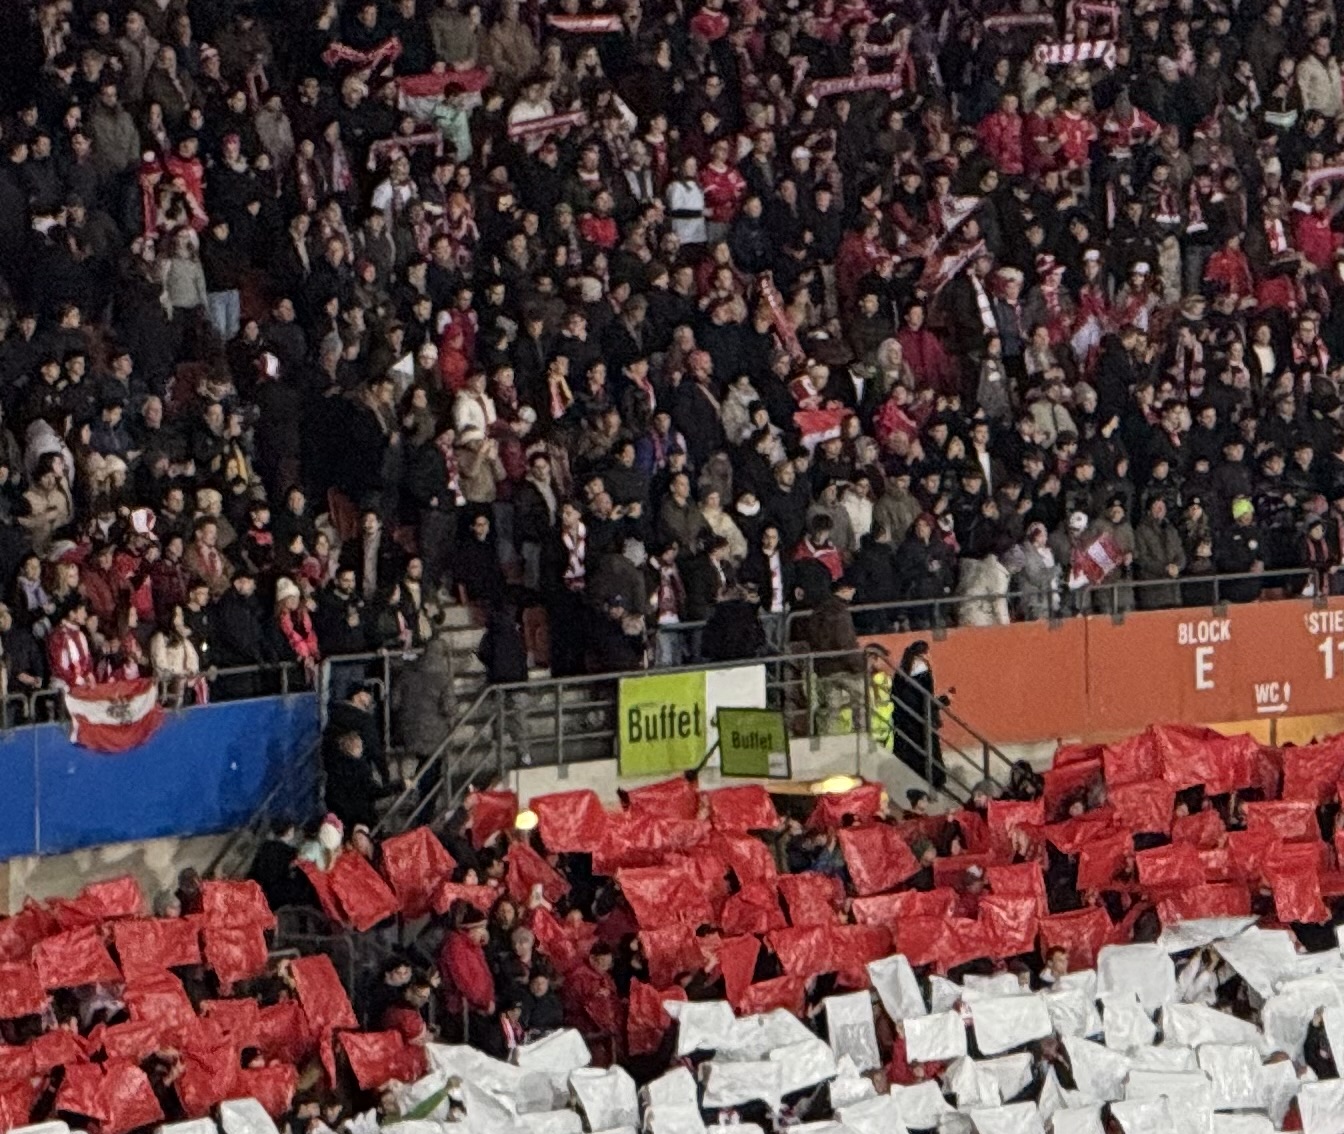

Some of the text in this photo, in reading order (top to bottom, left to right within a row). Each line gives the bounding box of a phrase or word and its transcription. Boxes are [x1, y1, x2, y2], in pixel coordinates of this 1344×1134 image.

[1177, 619, 1231, 645] BLOCK
[1196, 646, 1214, 690] E
[1254, 682, 1280, 704] WC
[627, 701, 701, 743] Buffet
[731, 731, 773, 750] Buffet
